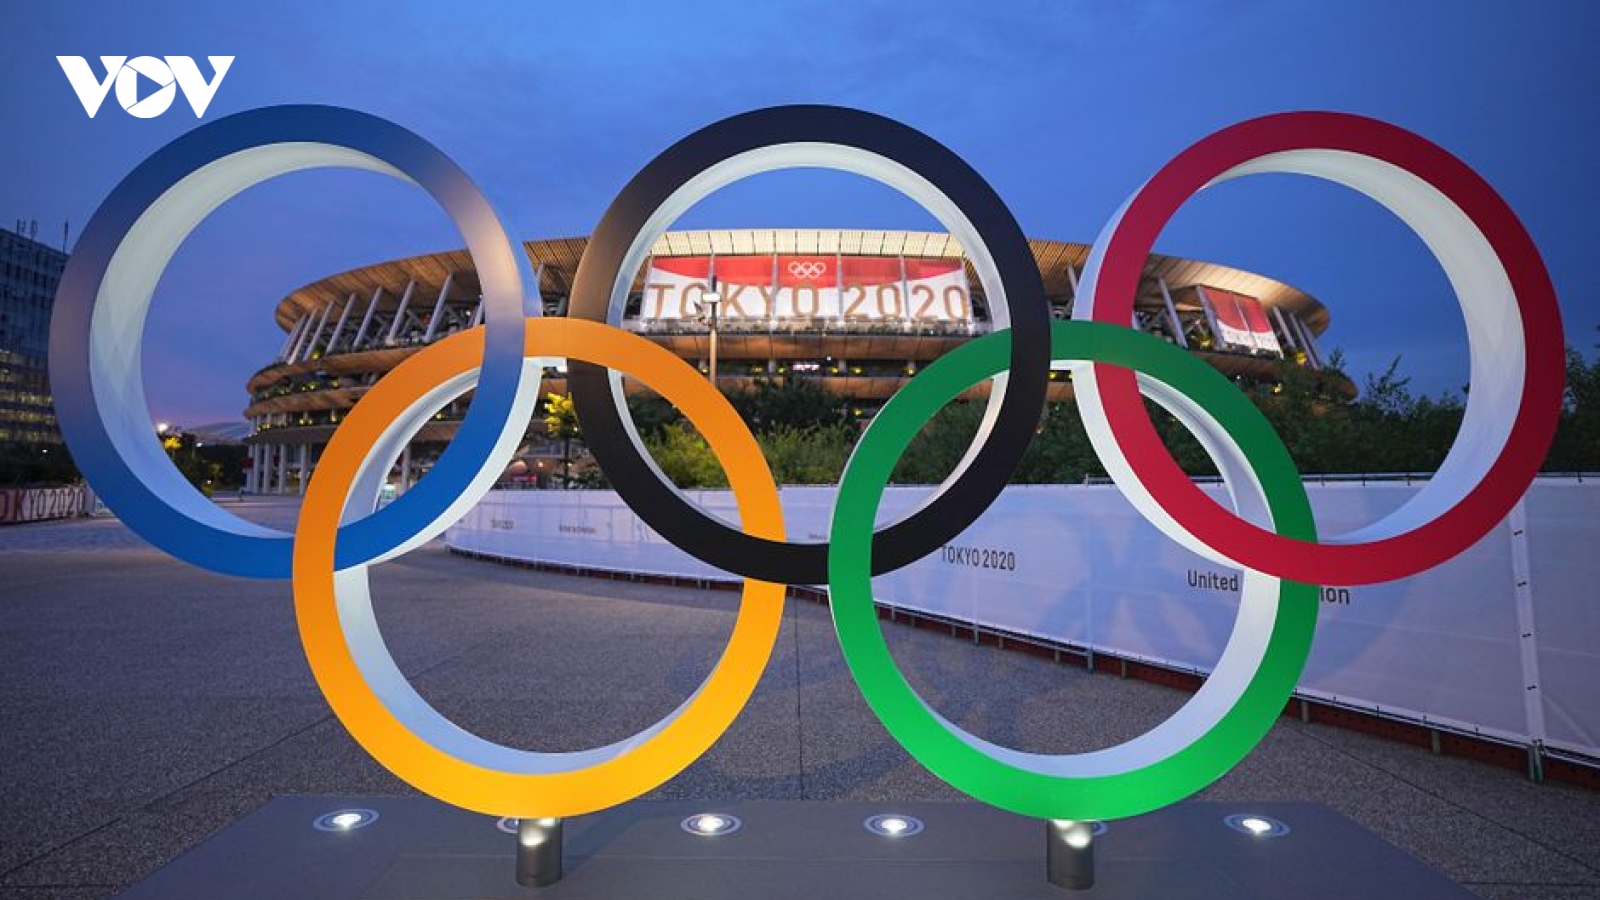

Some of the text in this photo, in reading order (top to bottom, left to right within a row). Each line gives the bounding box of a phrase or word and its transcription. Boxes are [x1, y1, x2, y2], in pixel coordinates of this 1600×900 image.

[647, 282, 970, 319] TOKYO 2020
[48, 487, 86, 517] 2020
[942, 544, 1015, 571] TOKYO 2020
[1187, 569, 1238, 592] United
